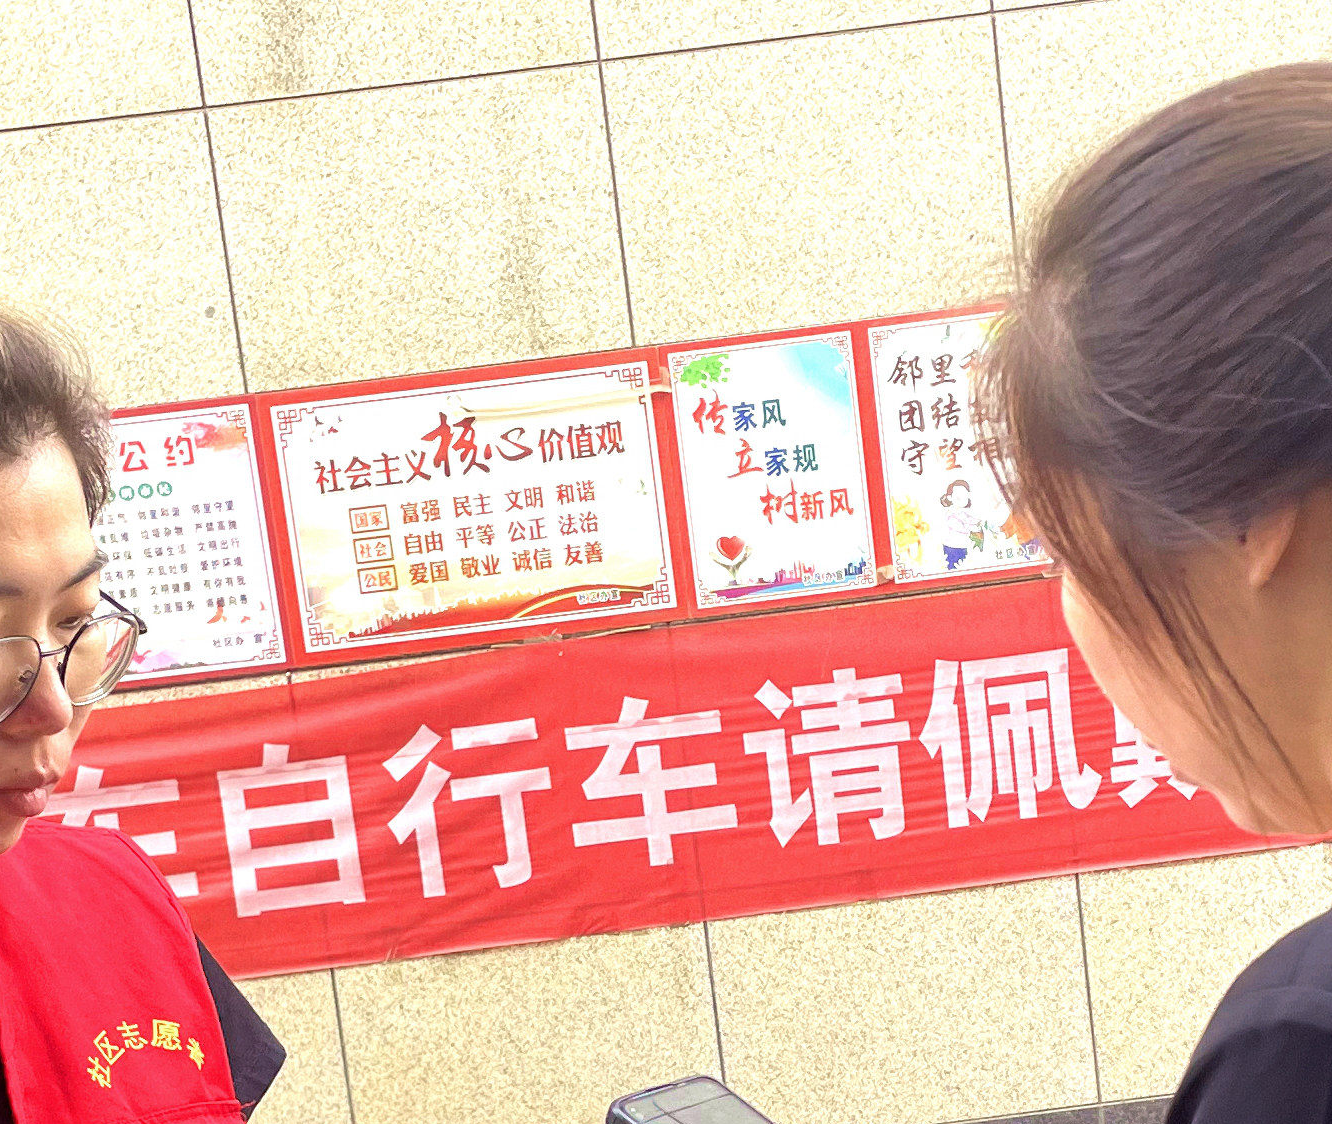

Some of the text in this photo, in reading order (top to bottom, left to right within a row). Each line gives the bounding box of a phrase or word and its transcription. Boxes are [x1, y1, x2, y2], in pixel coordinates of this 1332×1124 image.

[887, 348, 978, 393] 邻里
[691, 389, 787, 437] 传家风
[119, 436, 195, 473] 公约
[314, 411, 626, 495] 社会主义核心价值观
[727, 438, 819, 480] 立家规
[353, 480, 596, 529] 国家 富强 民主 文明 和谐
[759, 478, 855, 525] 树新风
[359, 511, 600, 559] 社会 自由 平等 公正 法治
[363, 541, 604, 589] 公民 爱国 敬业 诚信 友善
